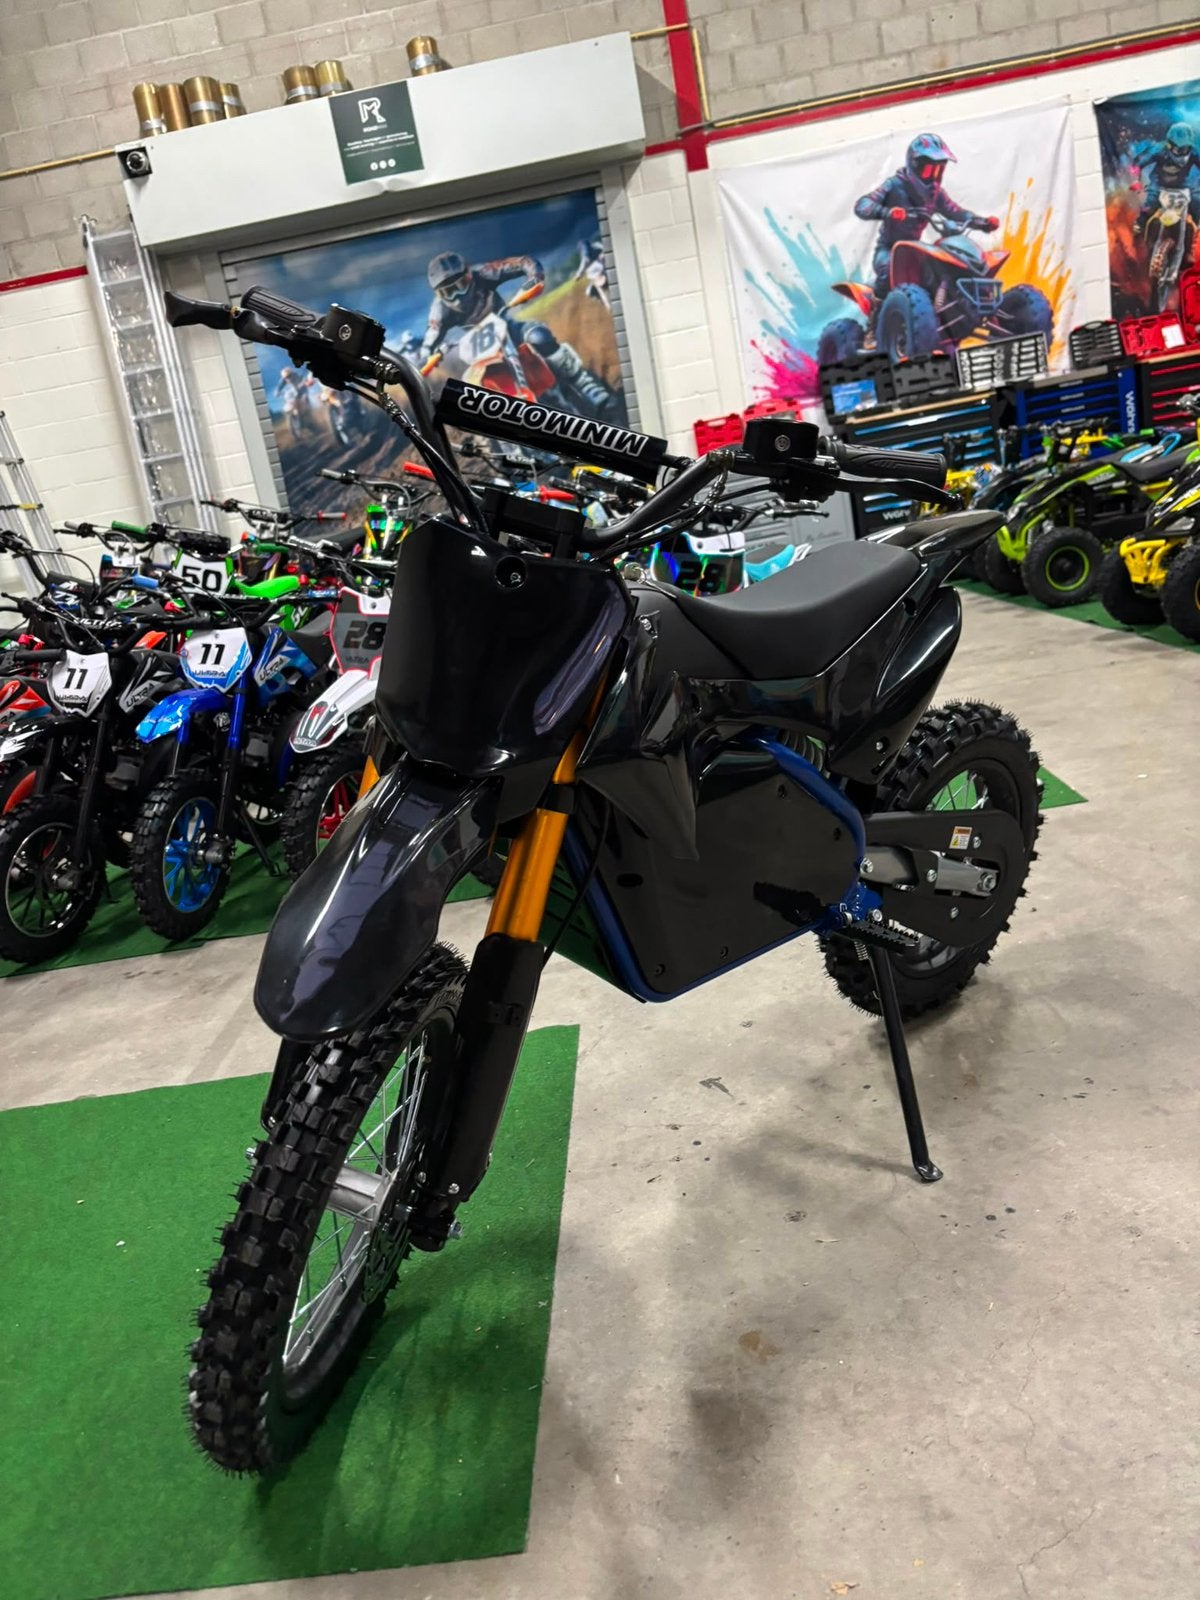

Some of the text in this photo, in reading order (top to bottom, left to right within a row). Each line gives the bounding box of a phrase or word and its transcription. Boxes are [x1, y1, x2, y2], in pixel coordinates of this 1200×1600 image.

[469, 321, 495, 354] 18
[458, 386, 648, 457] MINIMOTOR
[181, 565, 223, 592] 50
[343, 620, 387, 649] 28
[199, 643, 226, 665] 11
[63, 668, 89, 689] 11
[259, 657, 284, 681] ULTRA
[125, 682, 155, 708] ULTRA
